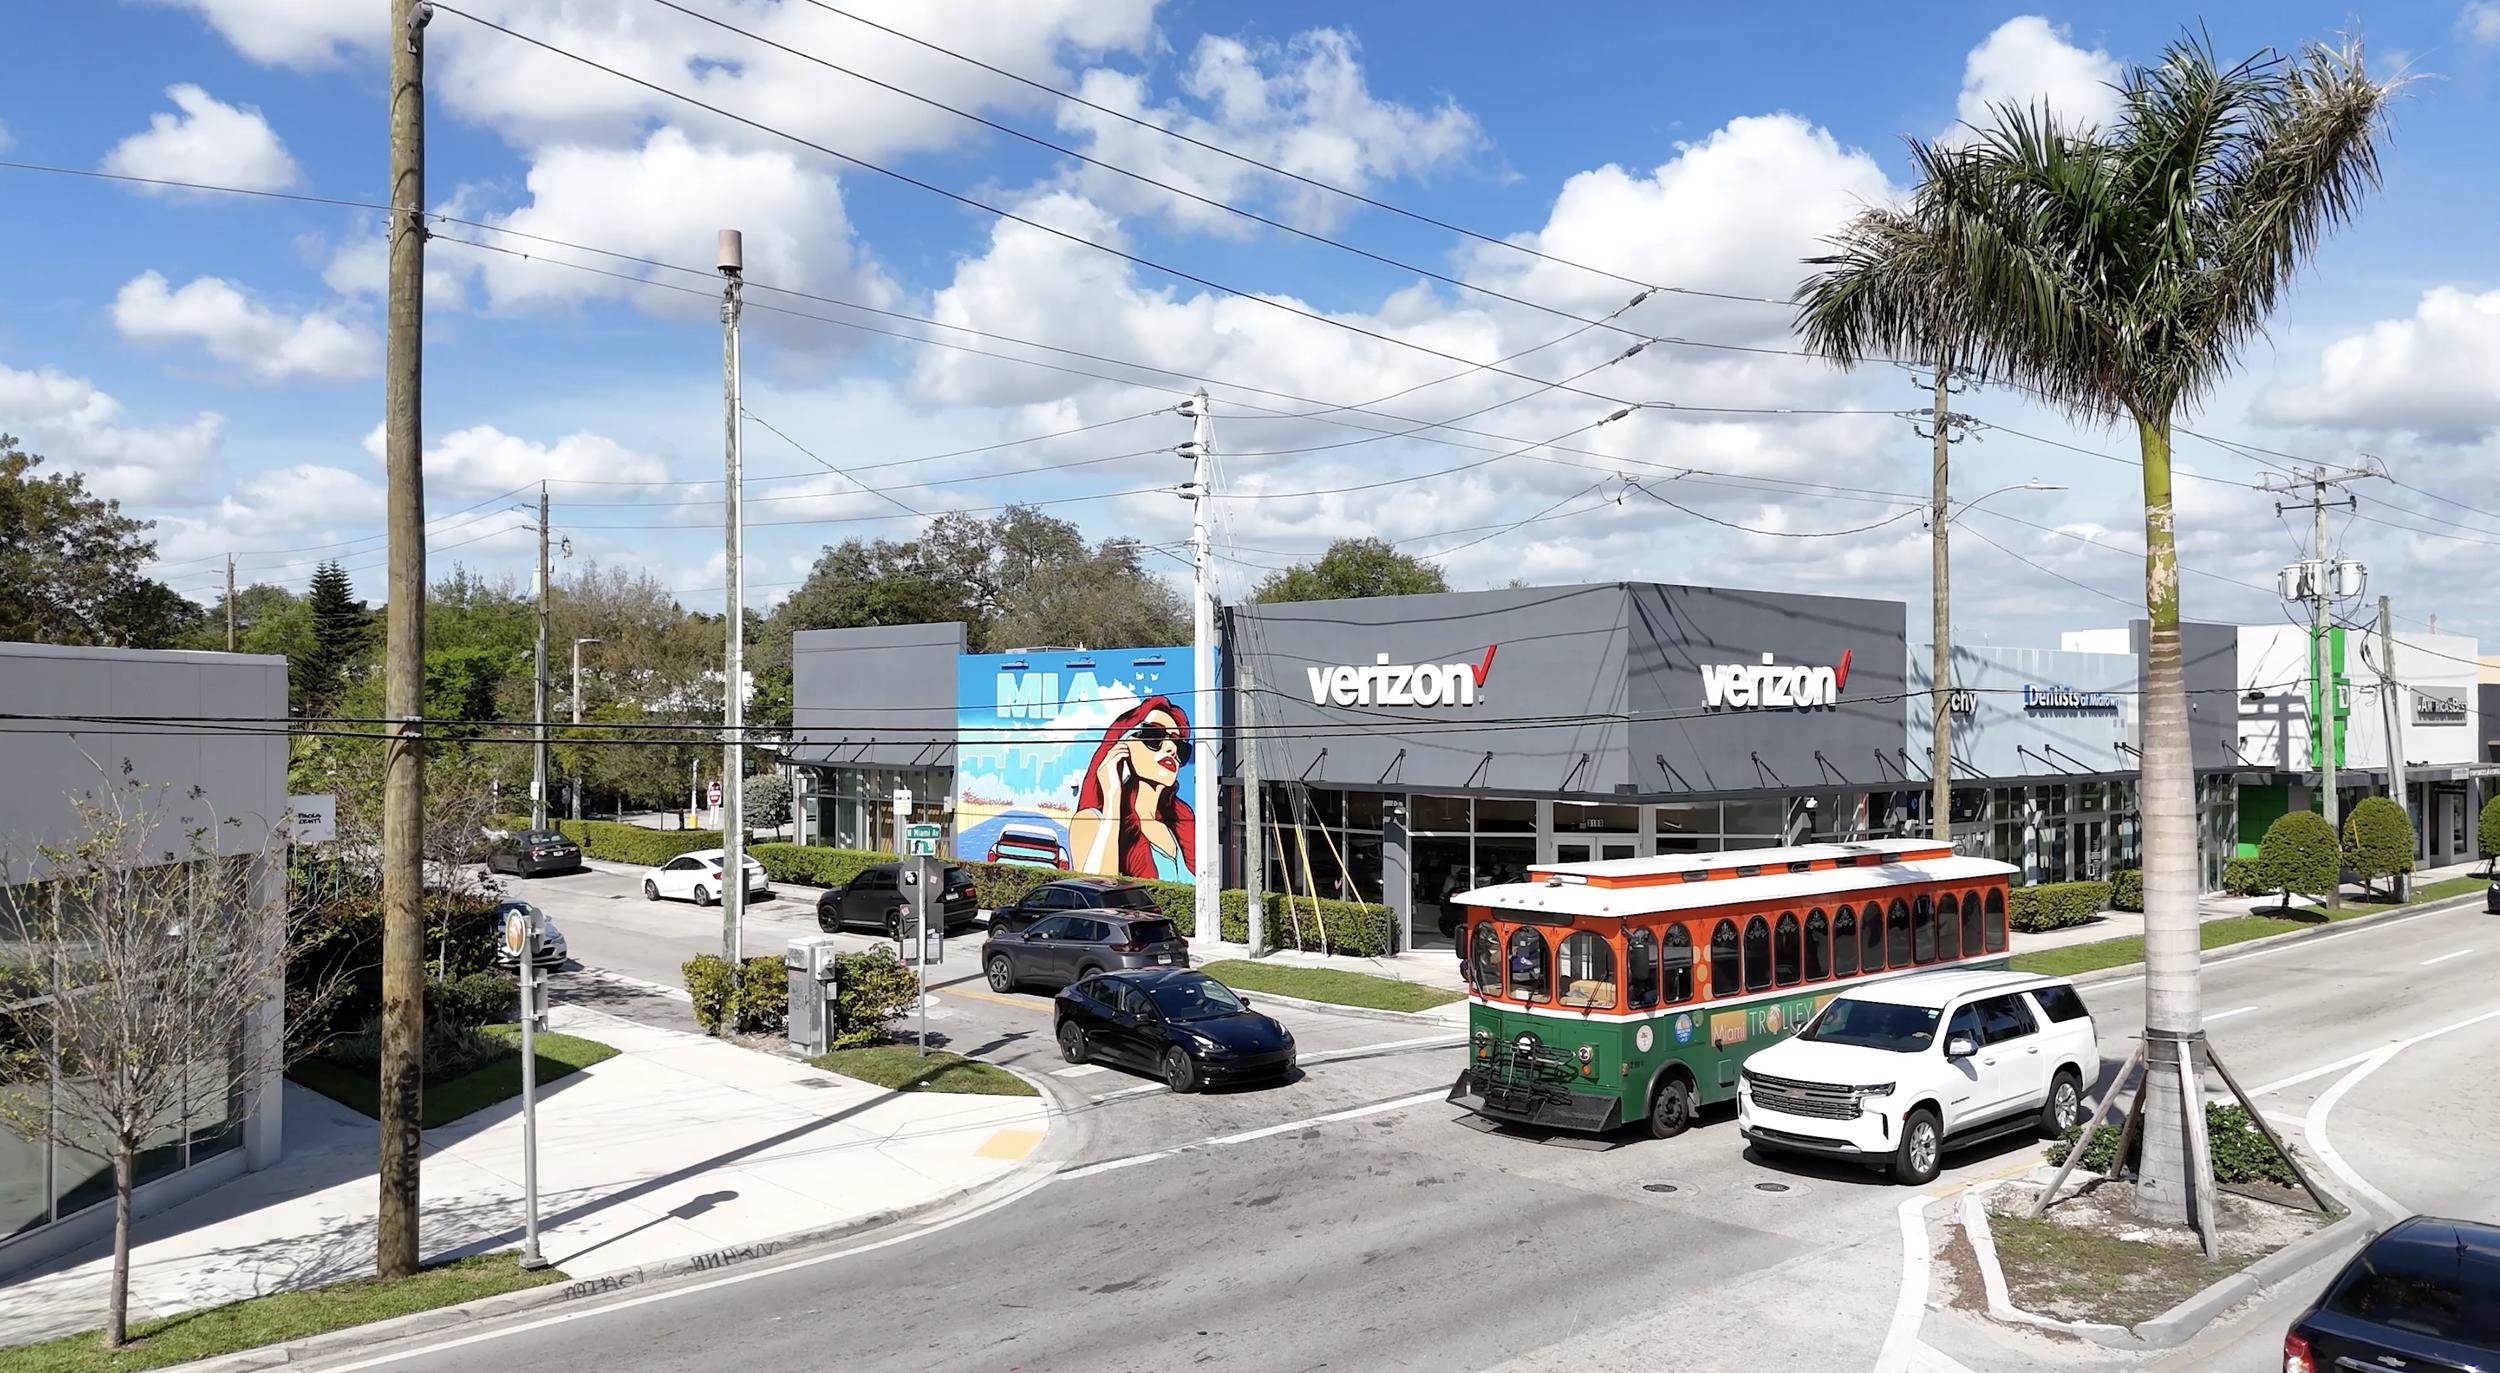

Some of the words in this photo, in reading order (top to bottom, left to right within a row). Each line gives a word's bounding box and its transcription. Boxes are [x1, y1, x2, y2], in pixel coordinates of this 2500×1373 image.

[996, 672, 1109, 718] MIA
[1306, 652, 1474, 706] verizon
[1700, 652, 1837, 707] verizon
[2029, 684, 2080, 707] Dentists
[907, 829, 912, 837] N
[913, 829, 931, 837] Miami
[1712, 1022, 1746, 1044] Miami
